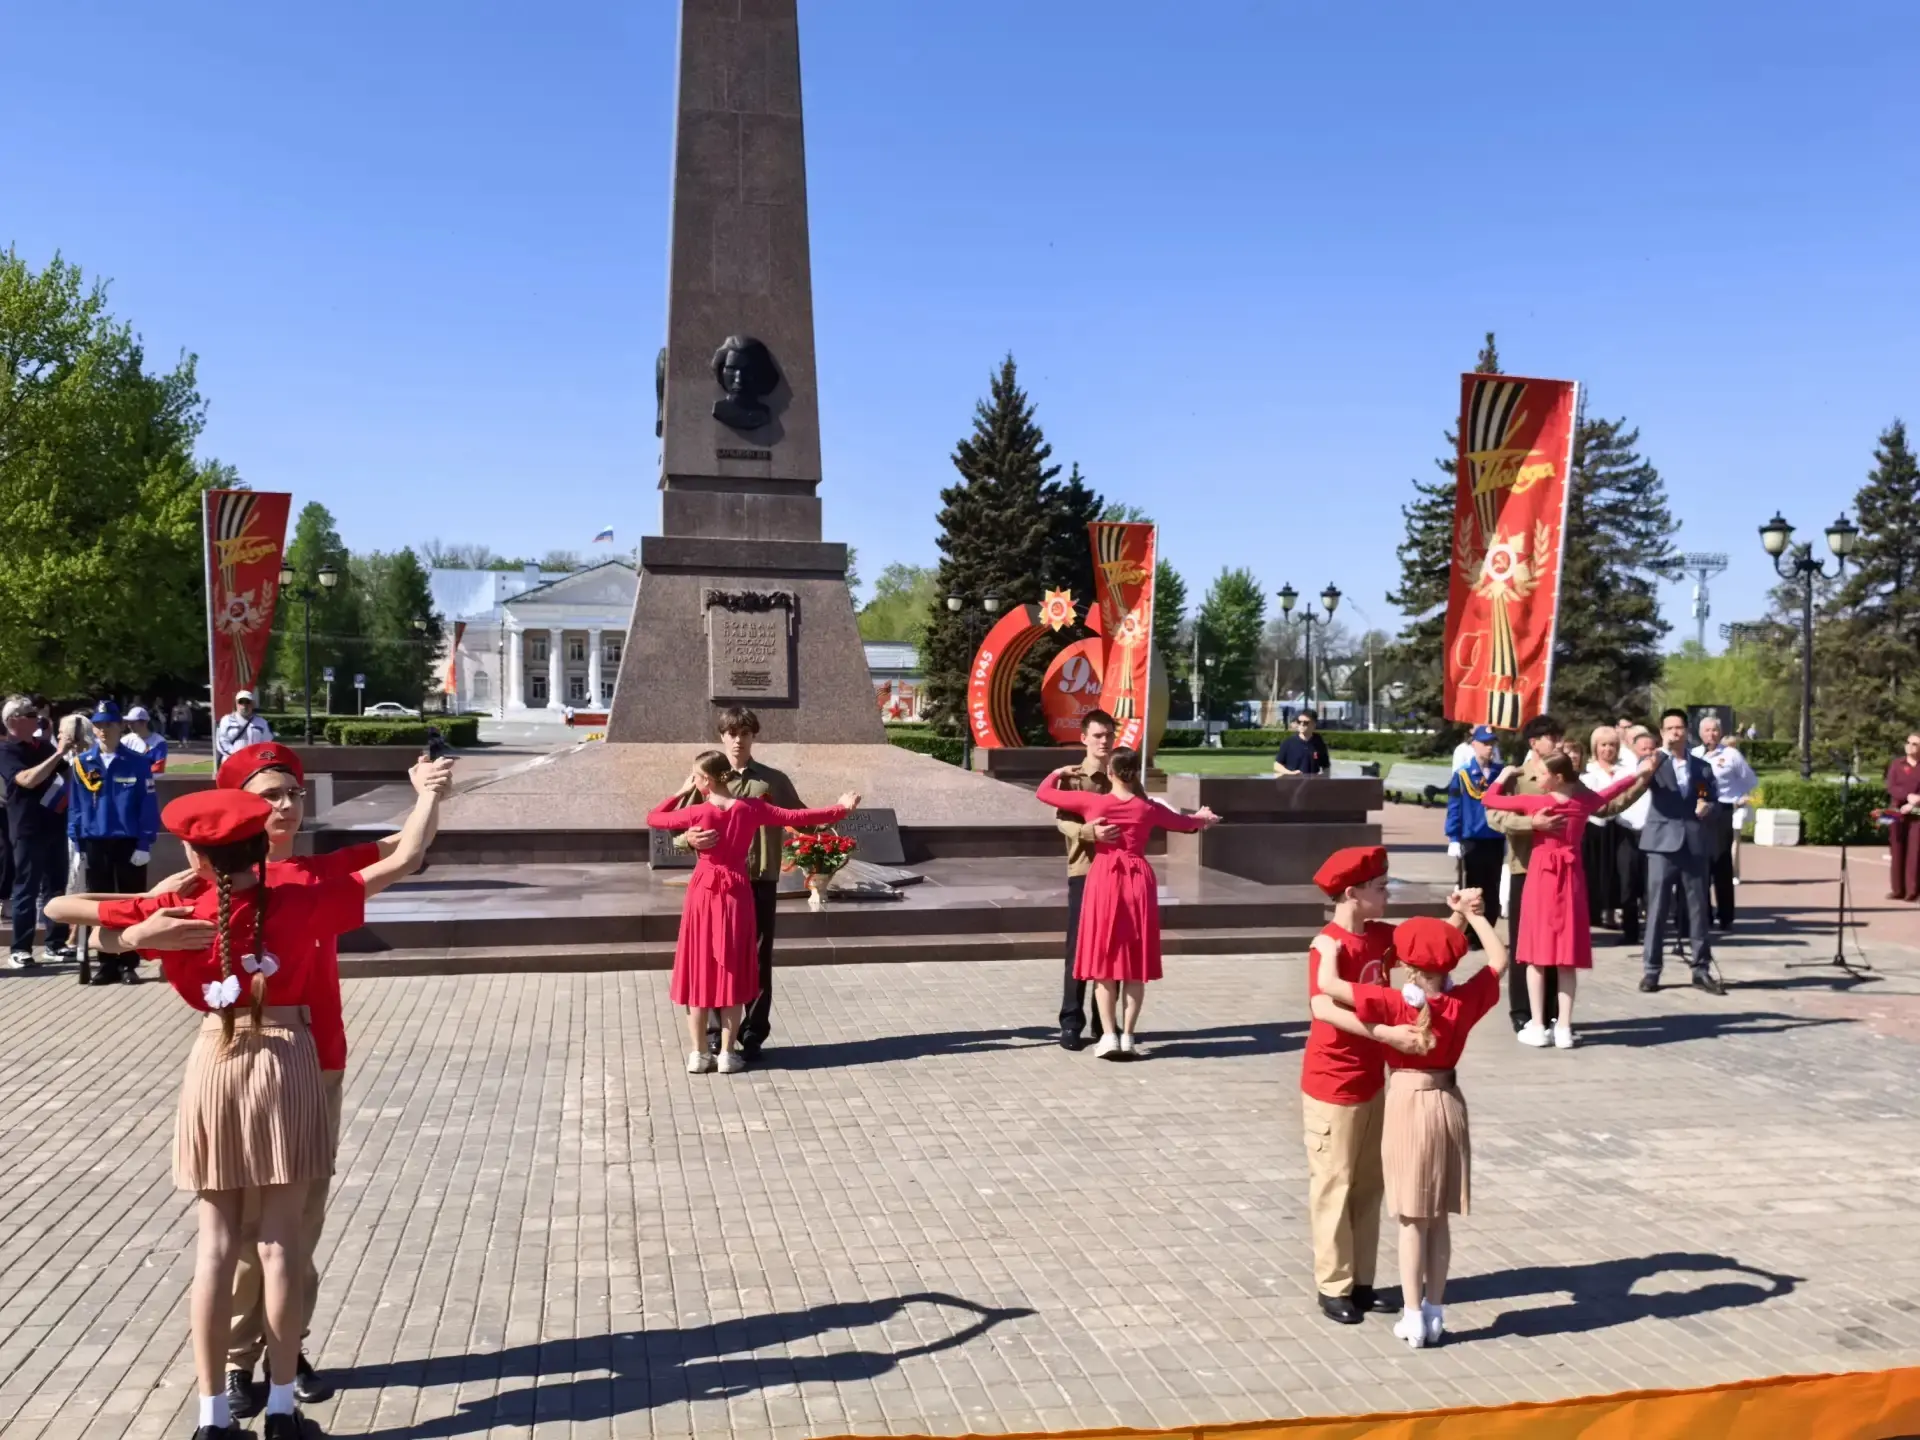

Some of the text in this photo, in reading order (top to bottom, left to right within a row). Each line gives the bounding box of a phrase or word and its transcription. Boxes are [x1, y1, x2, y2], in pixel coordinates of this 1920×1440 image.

[974, 650, 993, 686] 1945
[1058, 656, 1090, 693] 9
[973, 702, 990, 738] 1941
